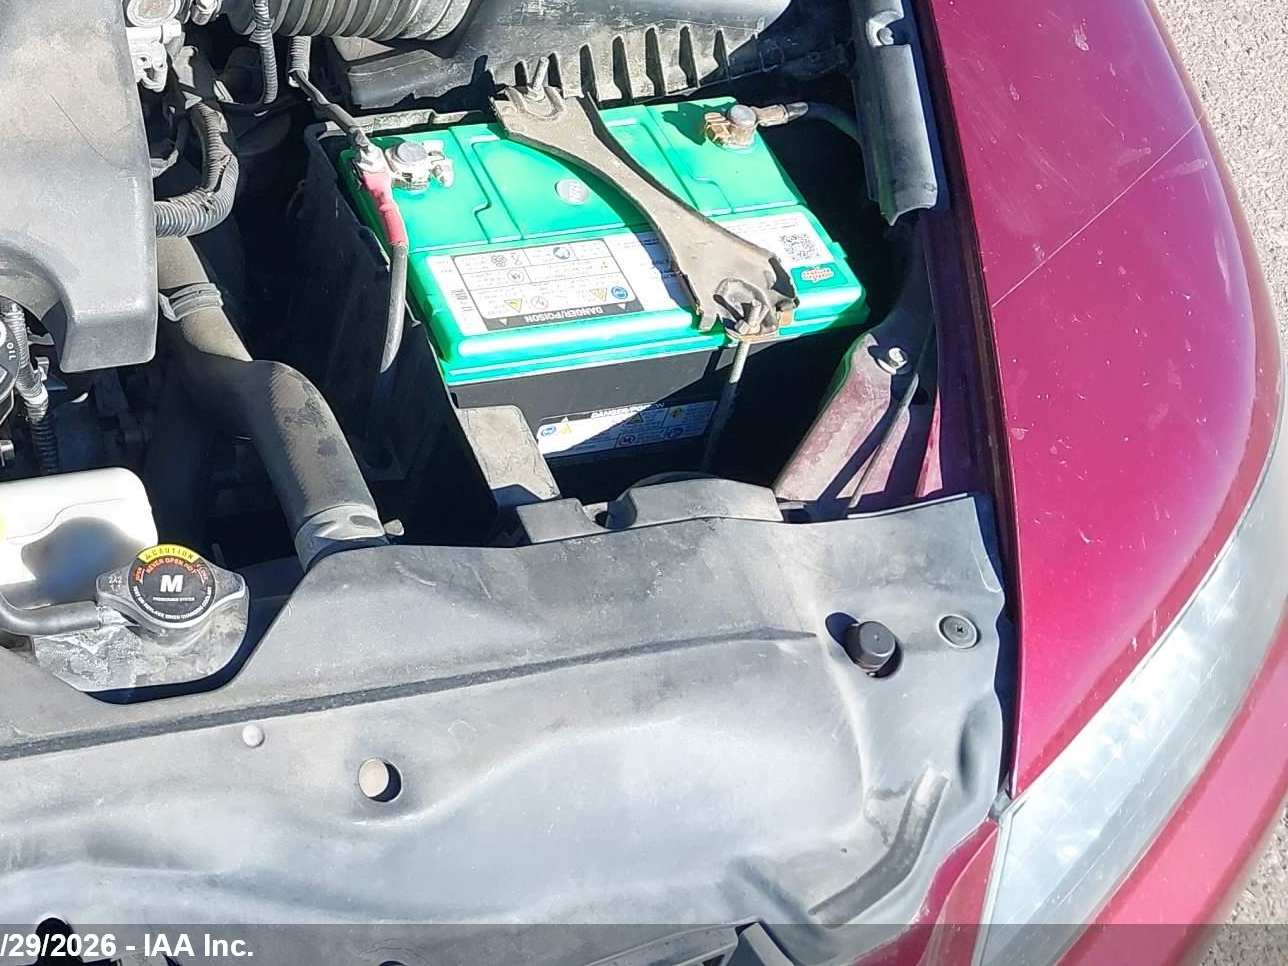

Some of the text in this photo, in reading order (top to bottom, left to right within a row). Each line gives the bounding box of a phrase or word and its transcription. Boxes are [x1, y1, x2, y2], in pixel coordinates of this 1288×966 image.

[524, 306, 604, 323] DANGER/POISON
[6, 342, 17, 361] OIL
[152, 547, 194, 560] CAUTION
[147, 558, 165, 573] NEVER
[165, 557, 184, 566] OPEN
[160, 574, 184, 593] M
